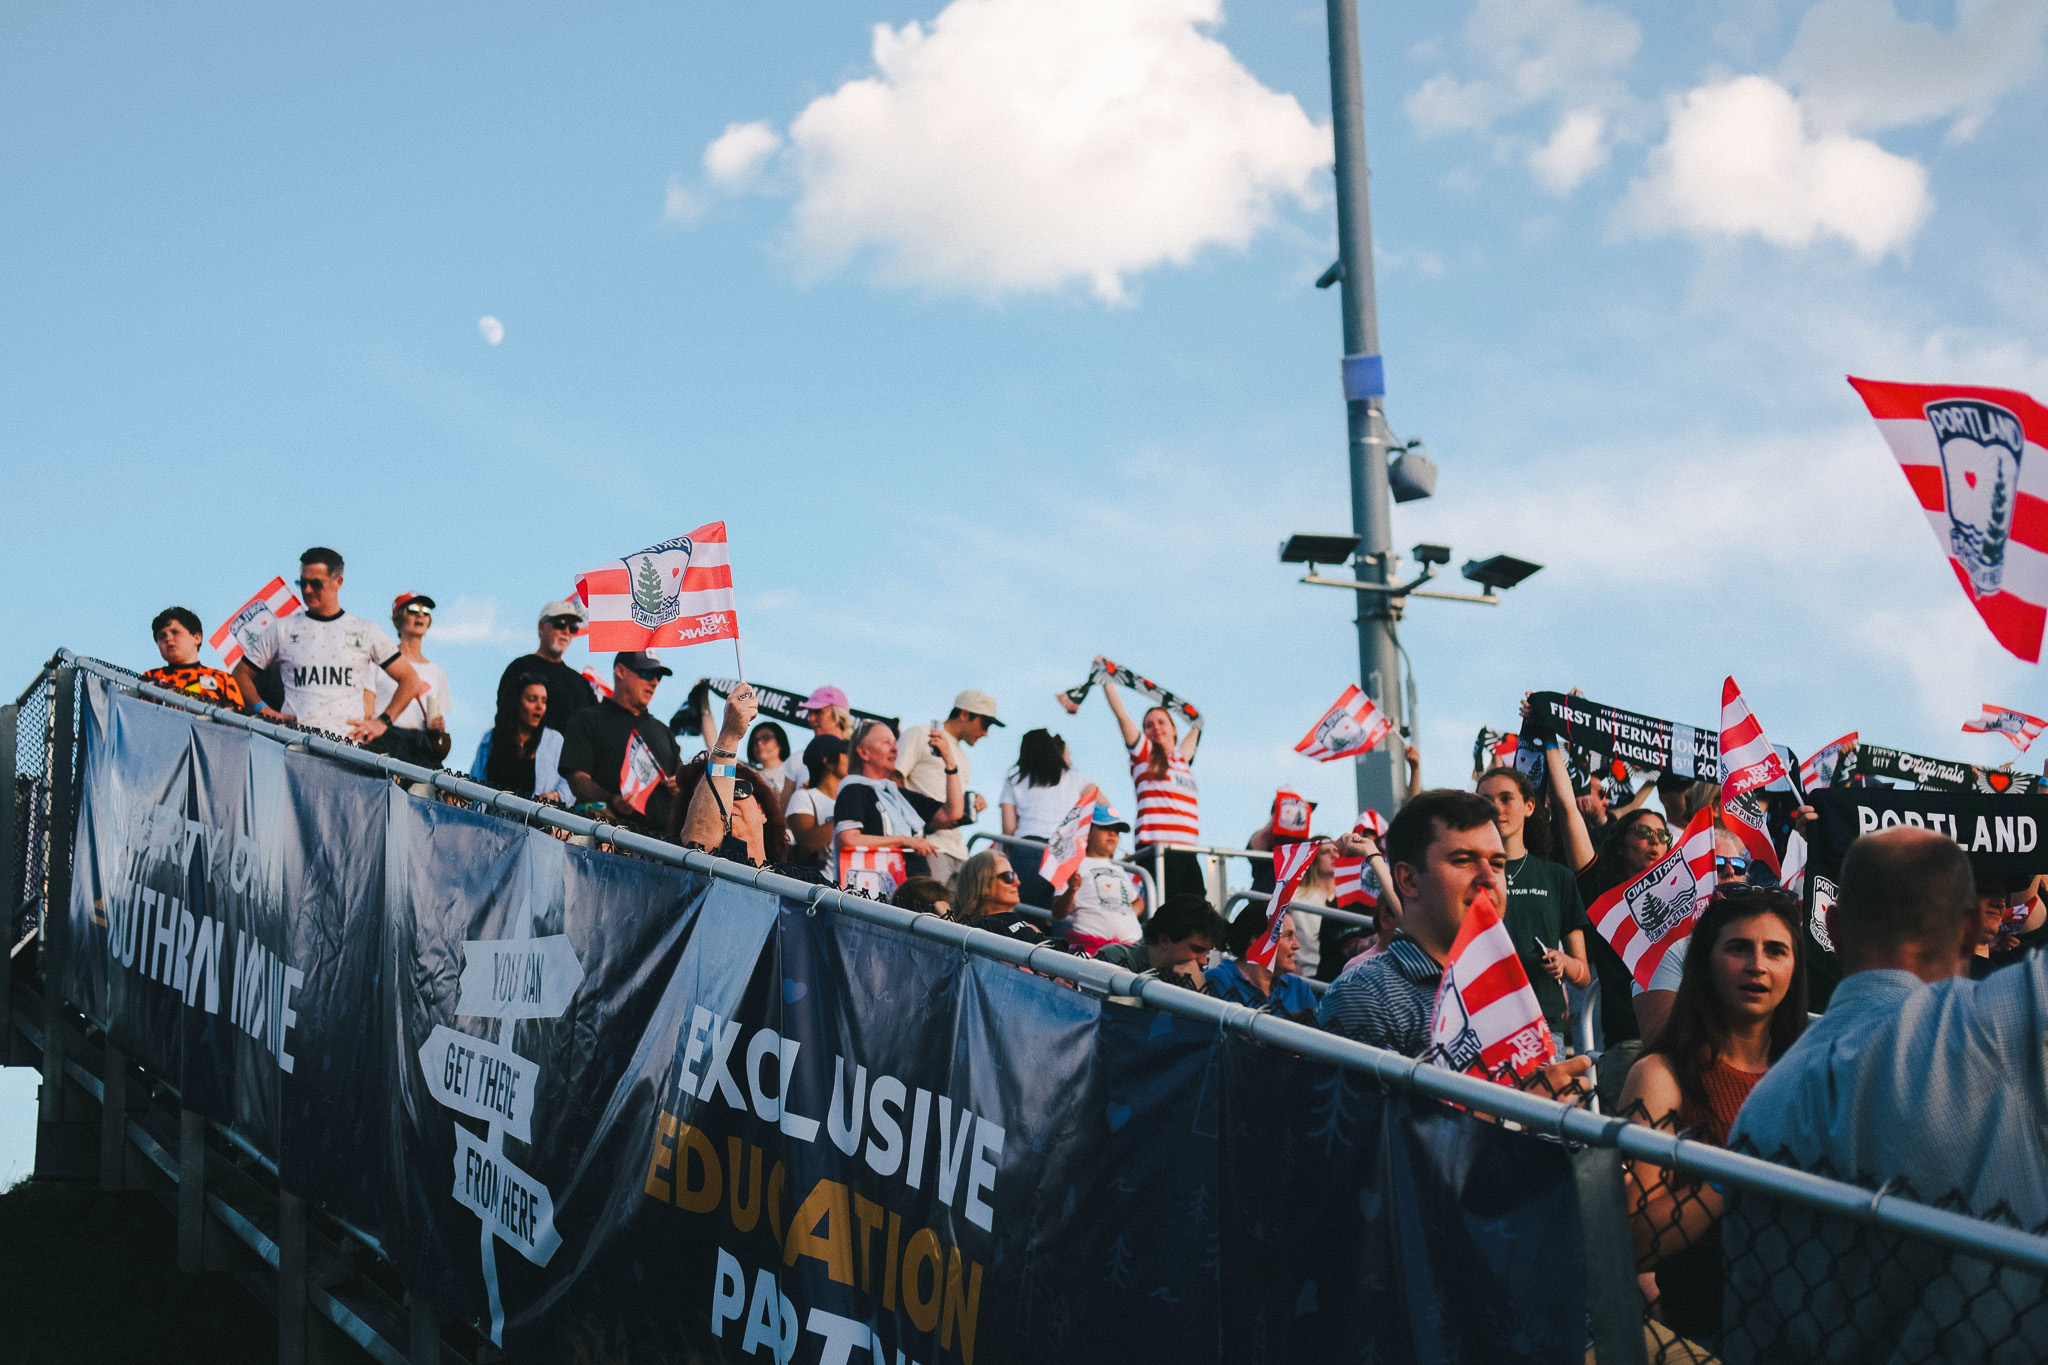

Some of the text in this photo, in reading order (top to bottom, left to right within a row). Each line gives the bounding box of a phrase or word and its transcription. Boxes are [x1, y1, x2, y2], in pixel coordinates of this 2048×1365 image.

[1929, 405, 2022, 452] PORTLAND
[754, 687, 791, 716] AINE,
[1550, 701, 1718, 762] FIRST INTERNATIONAL
[1613, 741, 1668, 767] AUGUST
[1872, 756, 1890, 769] CITY
[1898, 753, 1965, 784] Originals
[1740, 810, 1756, 826] PINE
[1816, 878, 1839, 901] PORTL
[492, 952, 545, 1004] YOU CAN
[443, 1042, 521, 1121] GET THERE
[678, 1004, 1006, 1233] EXCLUSIVE
[465, 1146, 538, 1248] FROM HERE
[644, 1109, 983, 1365] EDUCATION
